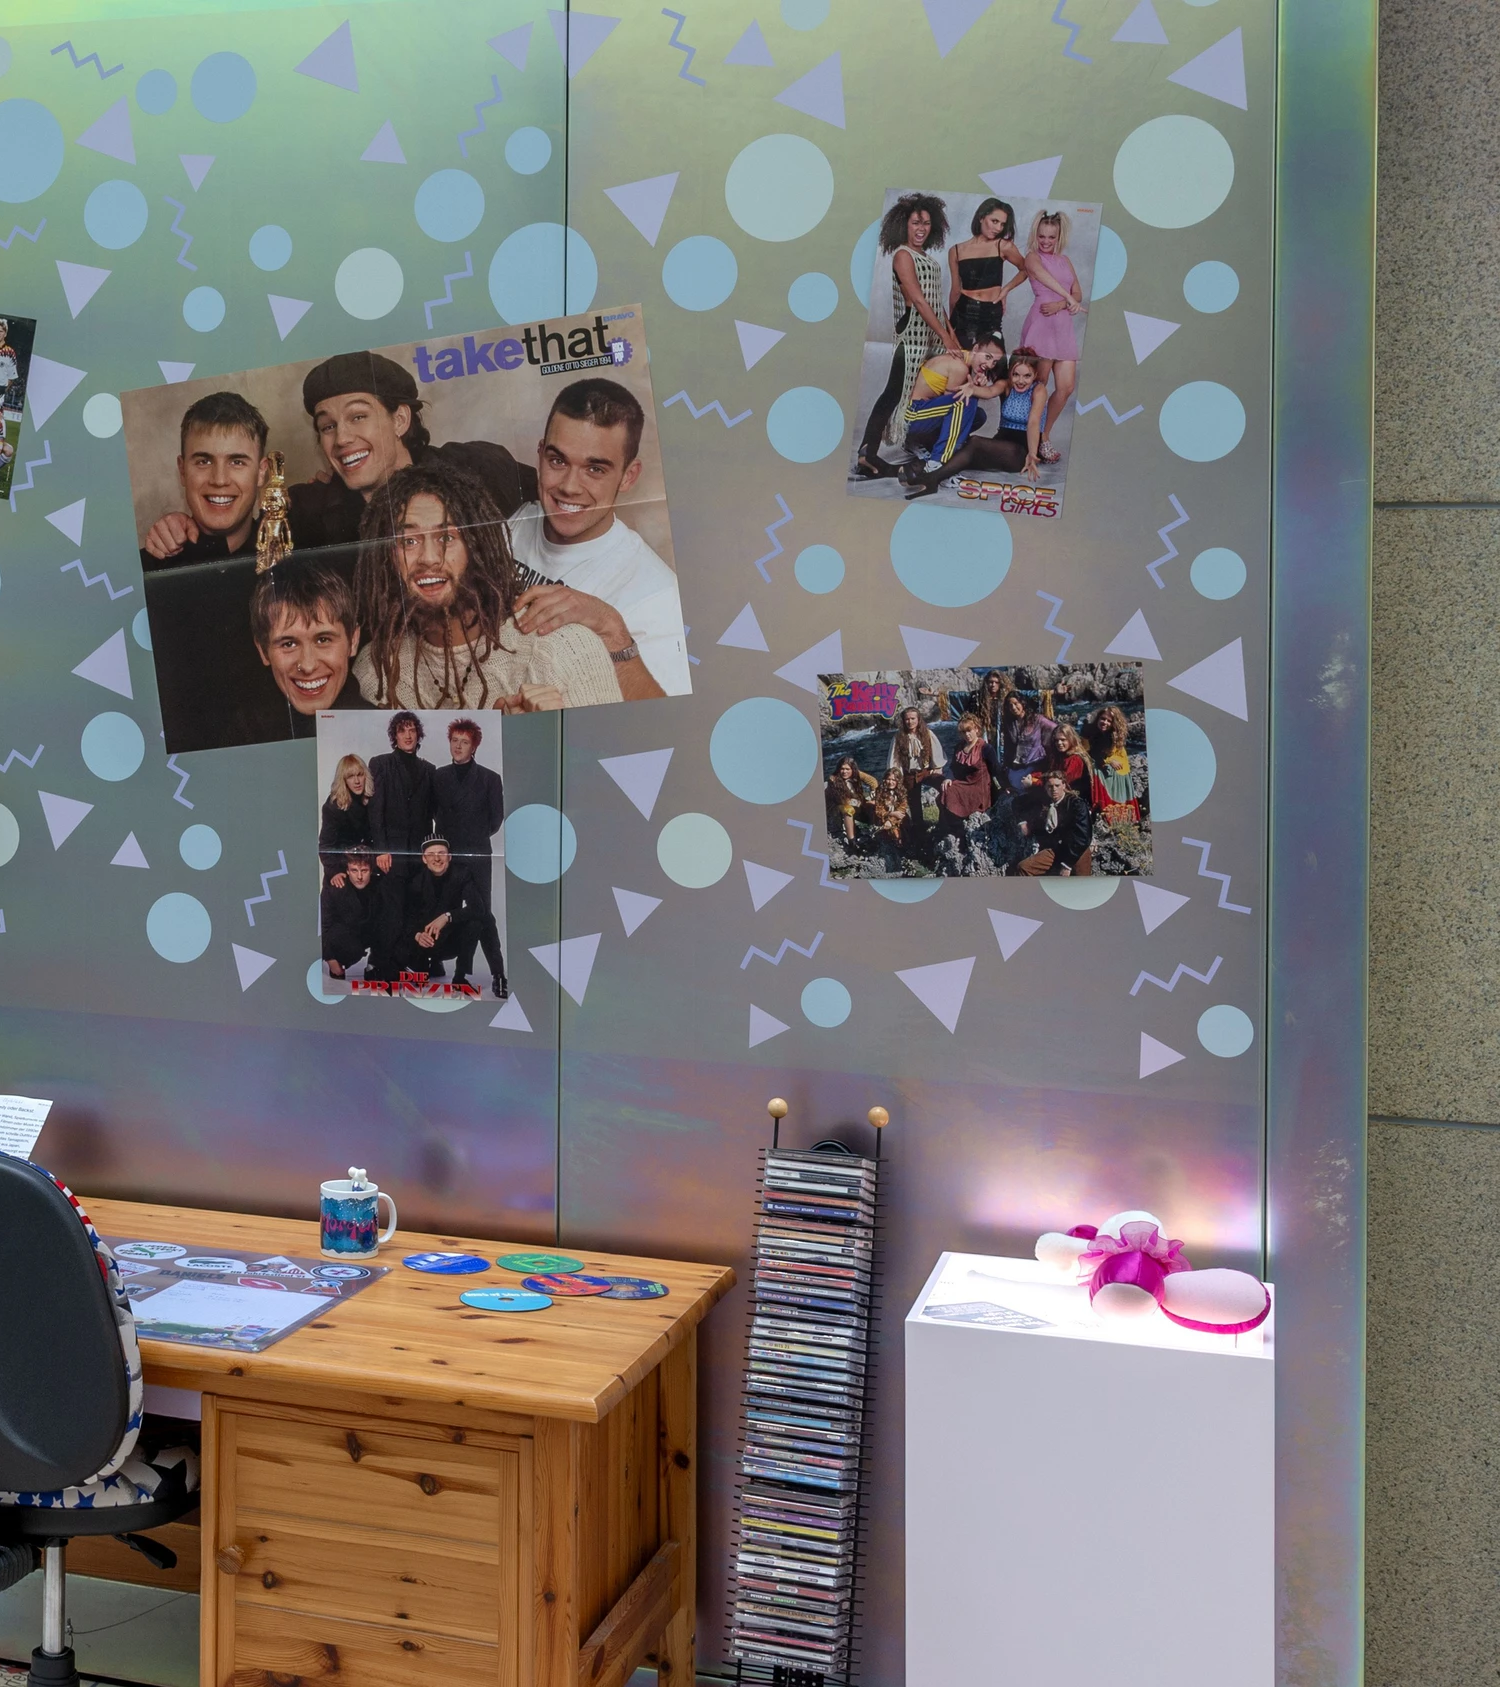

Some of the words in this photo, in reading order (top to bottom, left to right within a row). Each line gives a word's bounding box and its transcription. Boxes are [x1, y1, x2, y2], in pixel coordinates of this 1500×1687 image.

[603, 312, 635, 323] BRAVO
[542, 364, 565, 375] GOLDENE
[598, 356, 612, 367] 1994
[614, 352, 625, 363] POP
[958, 480, 1057, 509] SPICE
[1000, 496, 1058, 519] GIRLS
[830, 683, 852, 699] The
[851, 682, 899, 702] Kelly
[834, 697, 899, 717] Family
[399, 971, 429, 983] DIE
[351, 980, 482, 1000] PRINZEN
